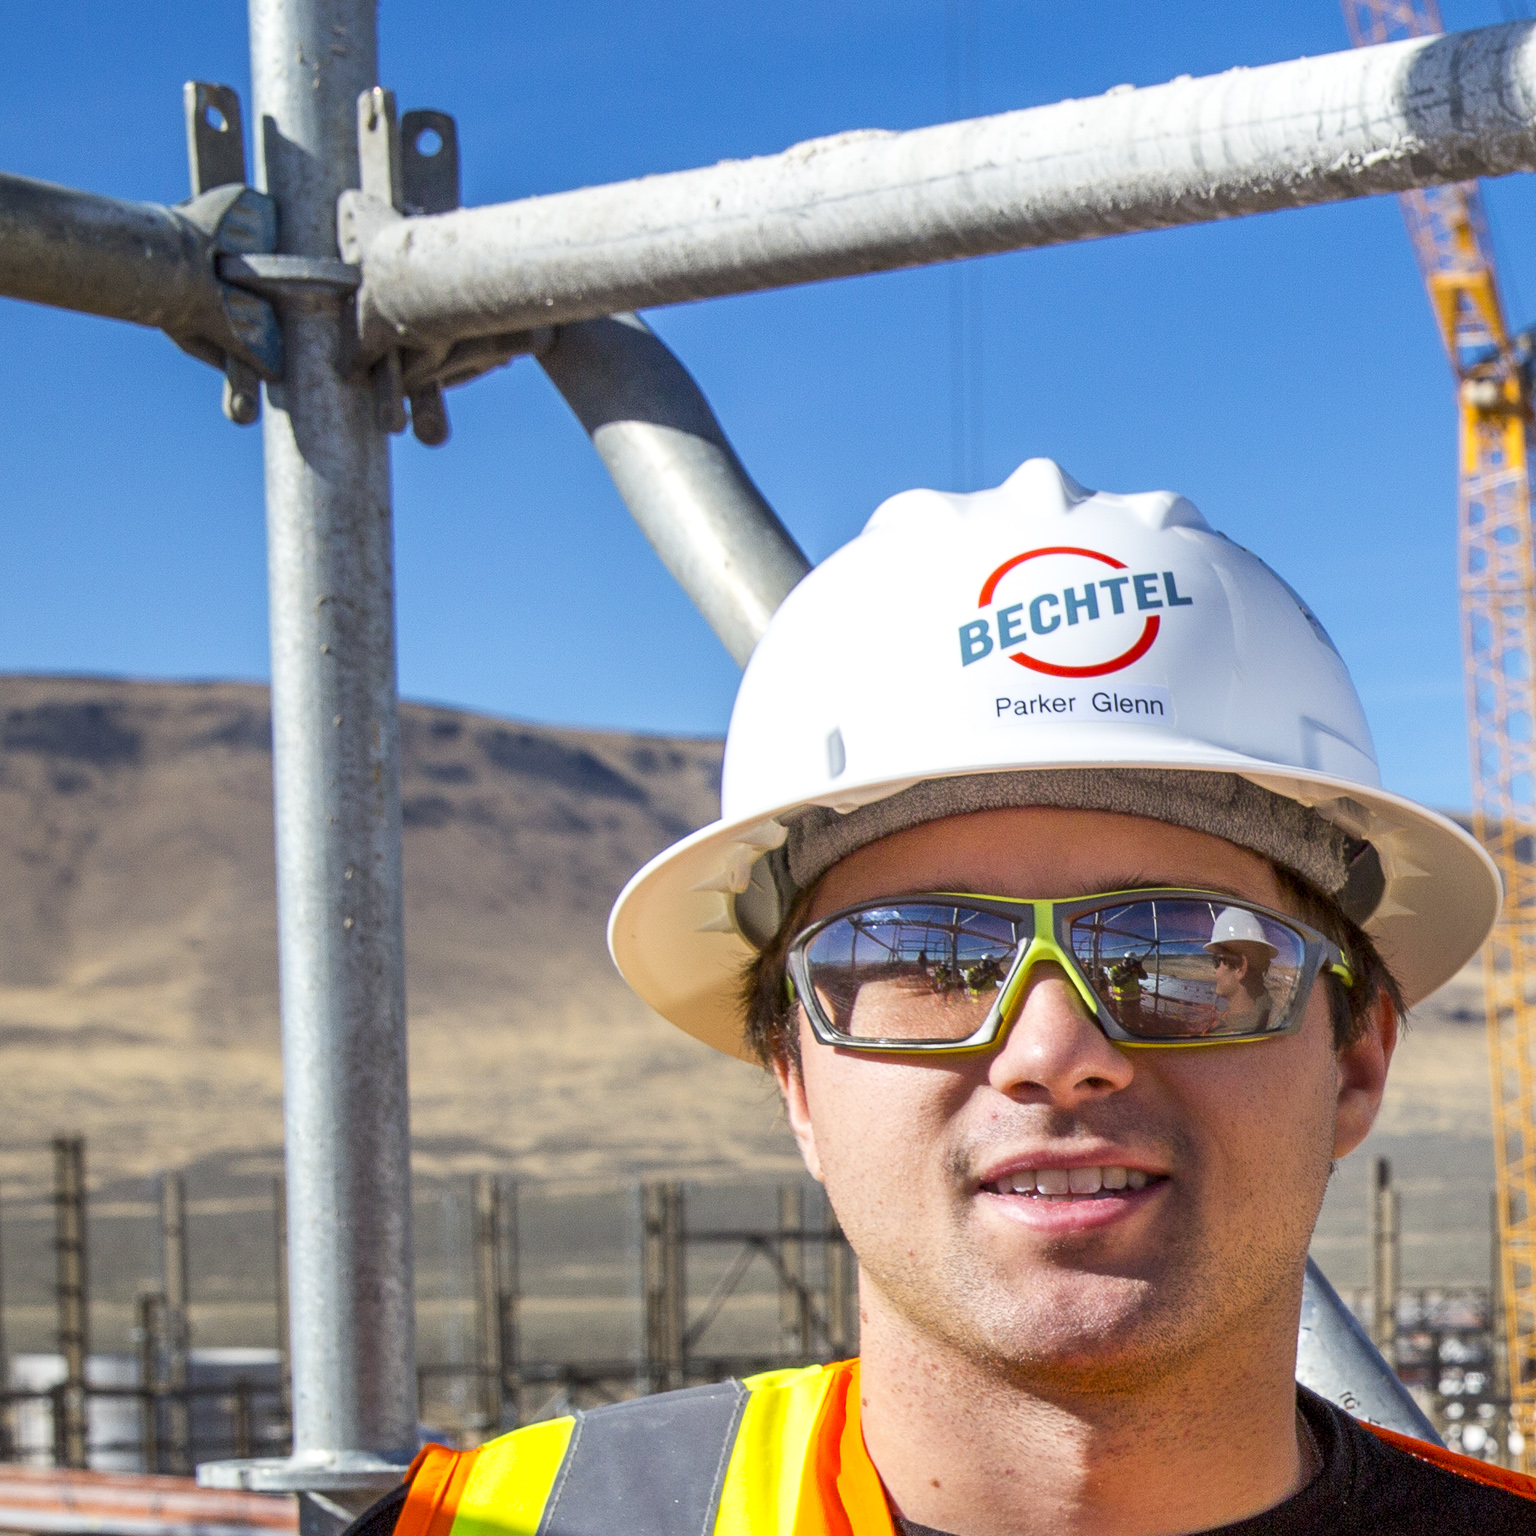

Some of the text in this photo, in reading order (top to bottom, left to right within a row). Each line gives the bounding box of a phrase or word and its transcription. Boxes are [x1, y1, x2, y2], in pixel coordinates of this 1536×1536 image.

[958, 570, 1193, 667] BECHTEL
[995, 691, 1165, 718] Parker Glenn
